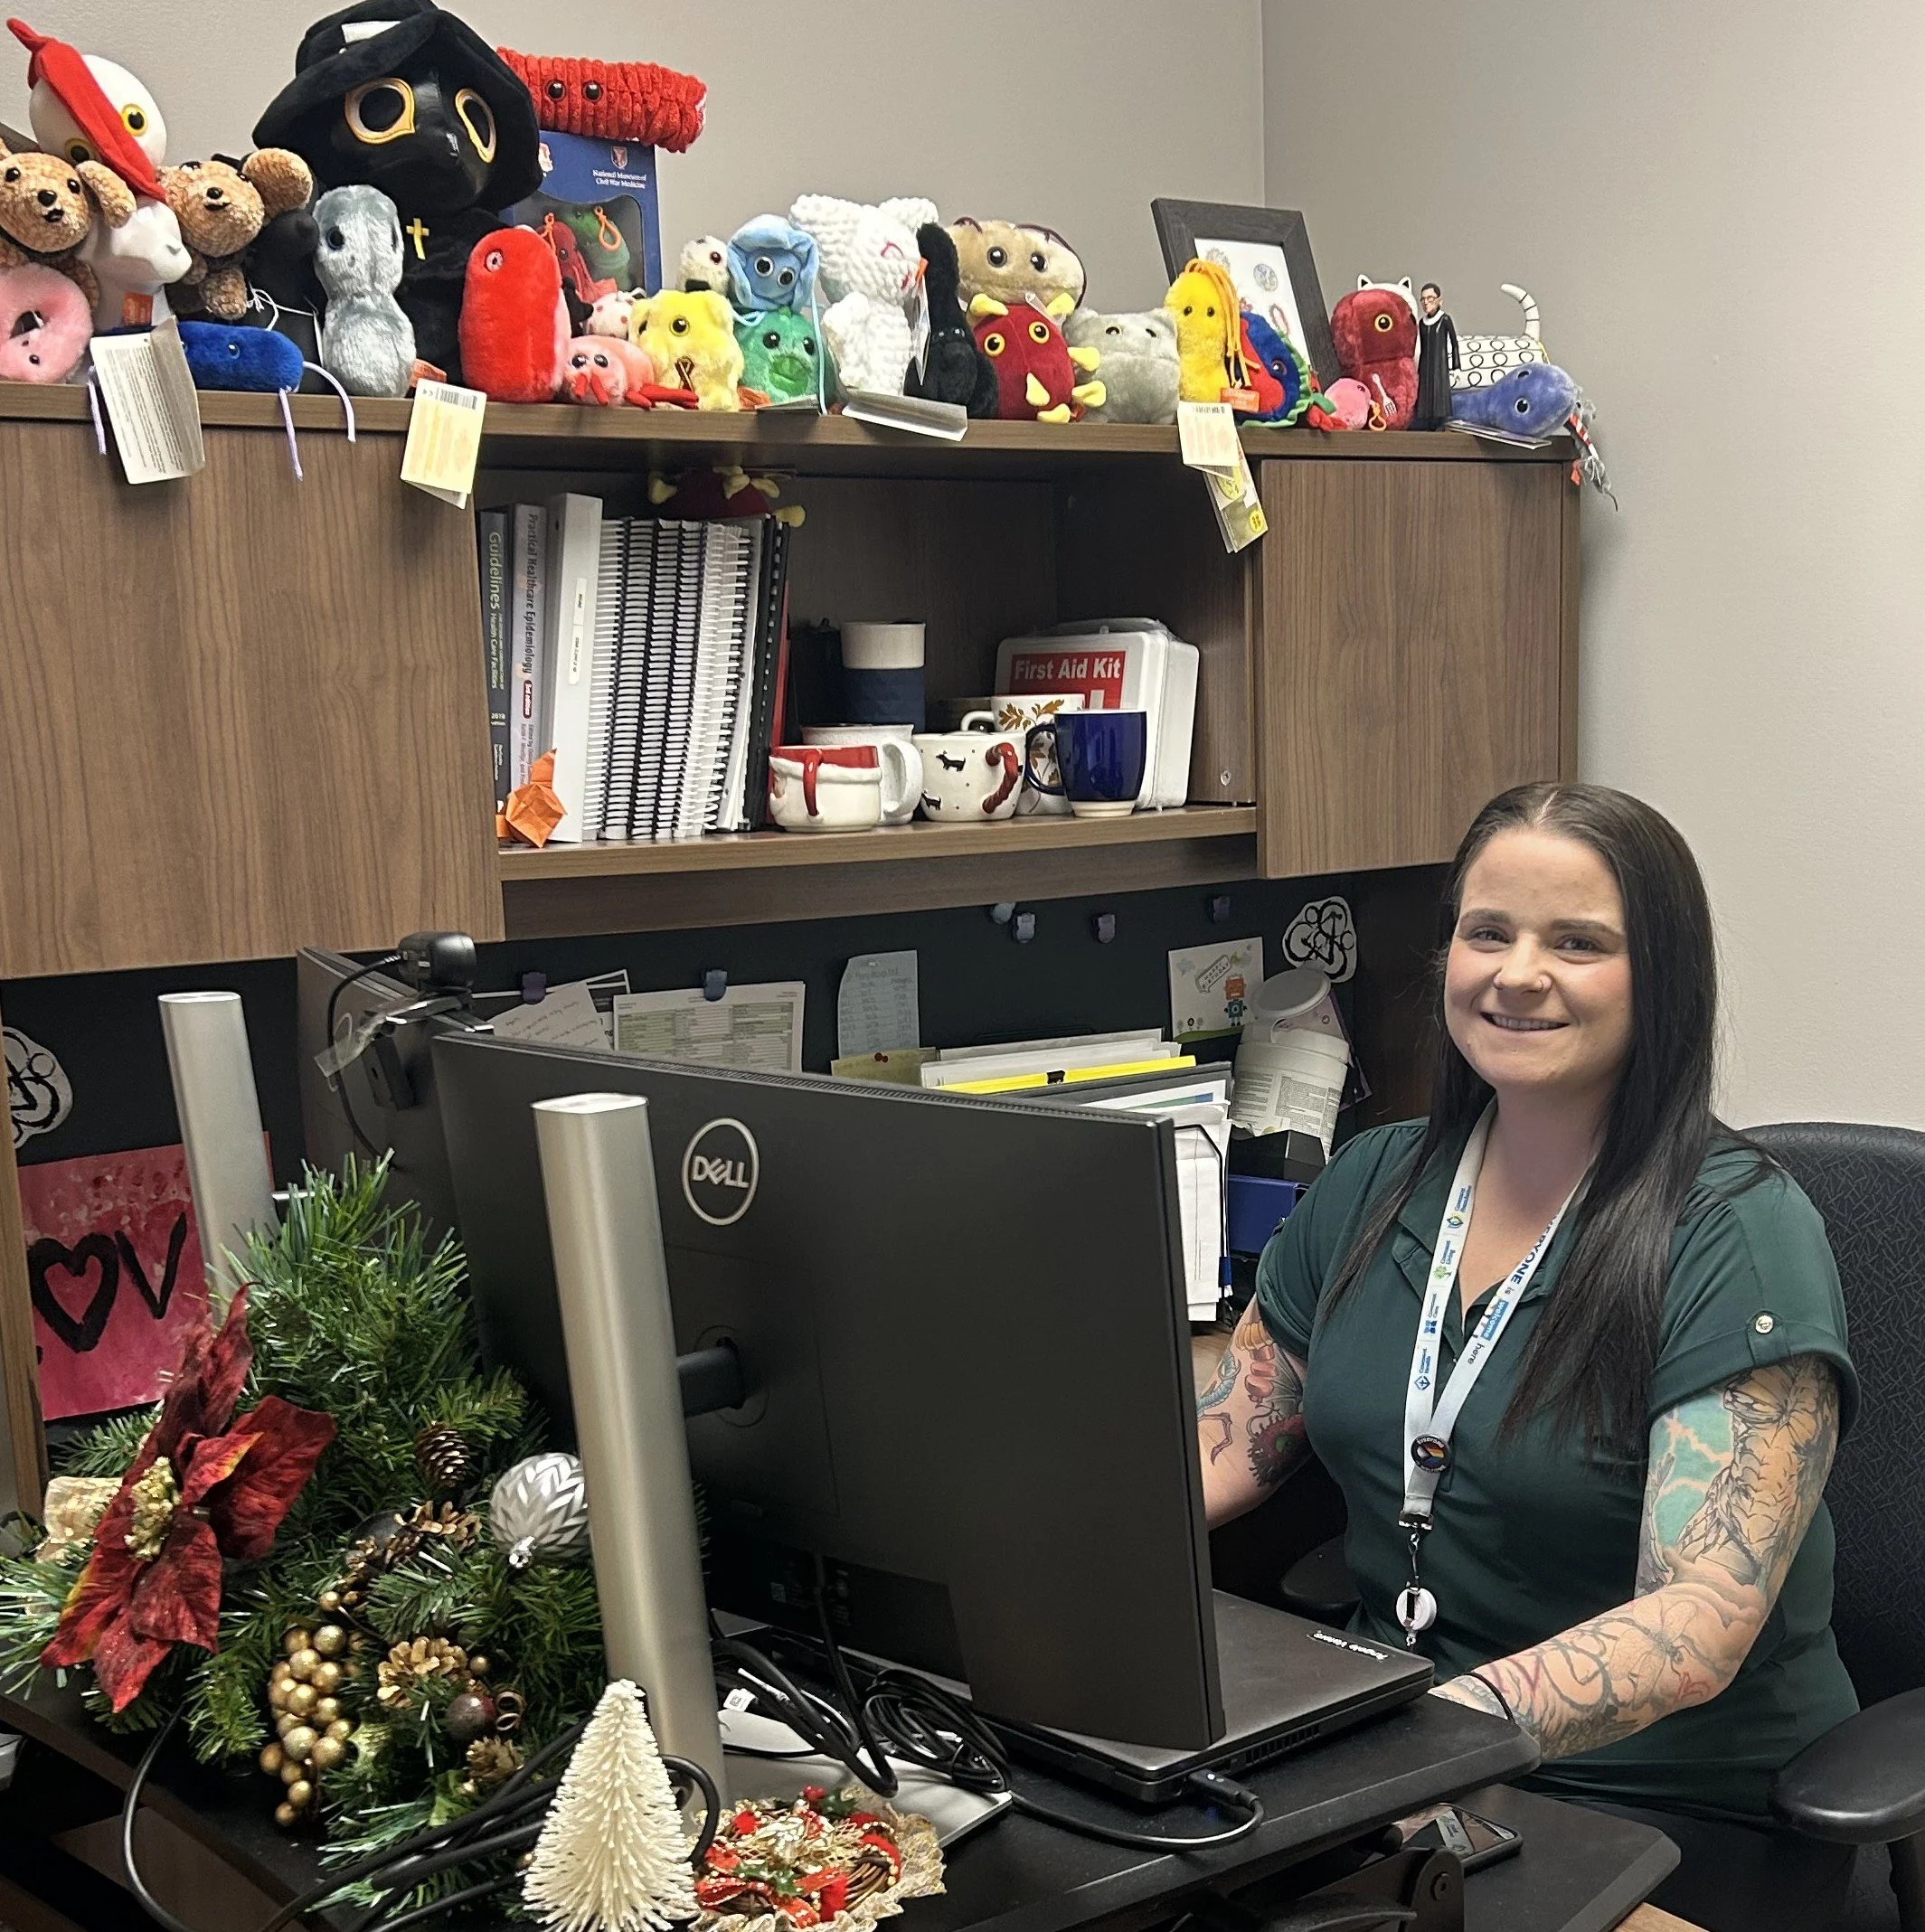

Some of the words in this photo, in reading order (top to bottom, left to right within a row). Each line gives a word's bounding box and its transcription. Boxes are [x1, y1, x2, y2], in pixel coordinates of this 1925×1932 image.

[527, 513, 539, 556] Practical
[489, 532, 503, 609] Guidelines
[526, 558, 538, 608] Healthcare
[522, 611, 536, 674] Epidemiology
[1014, 659, 1053, 680] First
[1057, 658, 1089, 679] Aid
[1093, 657, 1121, 679] Kit
[692, 1155, 750, 1189] DELL
[1505, 1286, 1515, 1296] is
[1483, 1301, 1507, 1339] welcome
[1467, 1343, 1486, 1365] here
